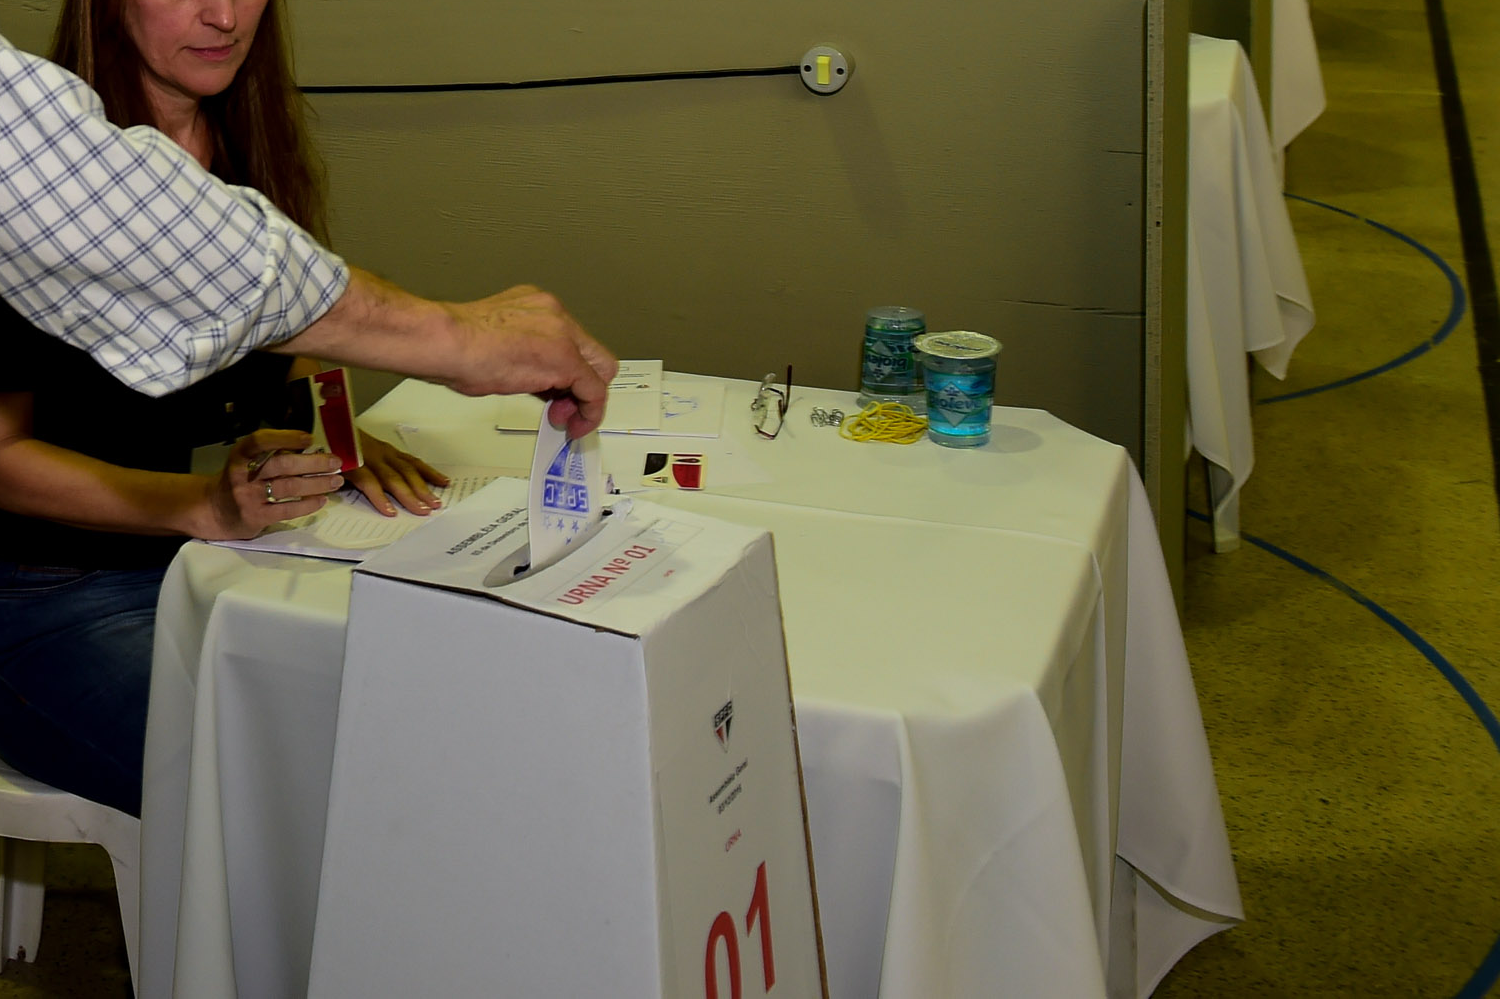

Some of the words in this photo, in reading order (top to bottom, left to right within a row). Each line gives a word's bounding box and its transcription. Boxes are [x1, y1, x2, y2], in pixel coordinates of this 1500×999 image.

[556, 575, 617, 605] URNA
[624, 544, 657, 559] 01
[704, 860, 776, 999] 01
